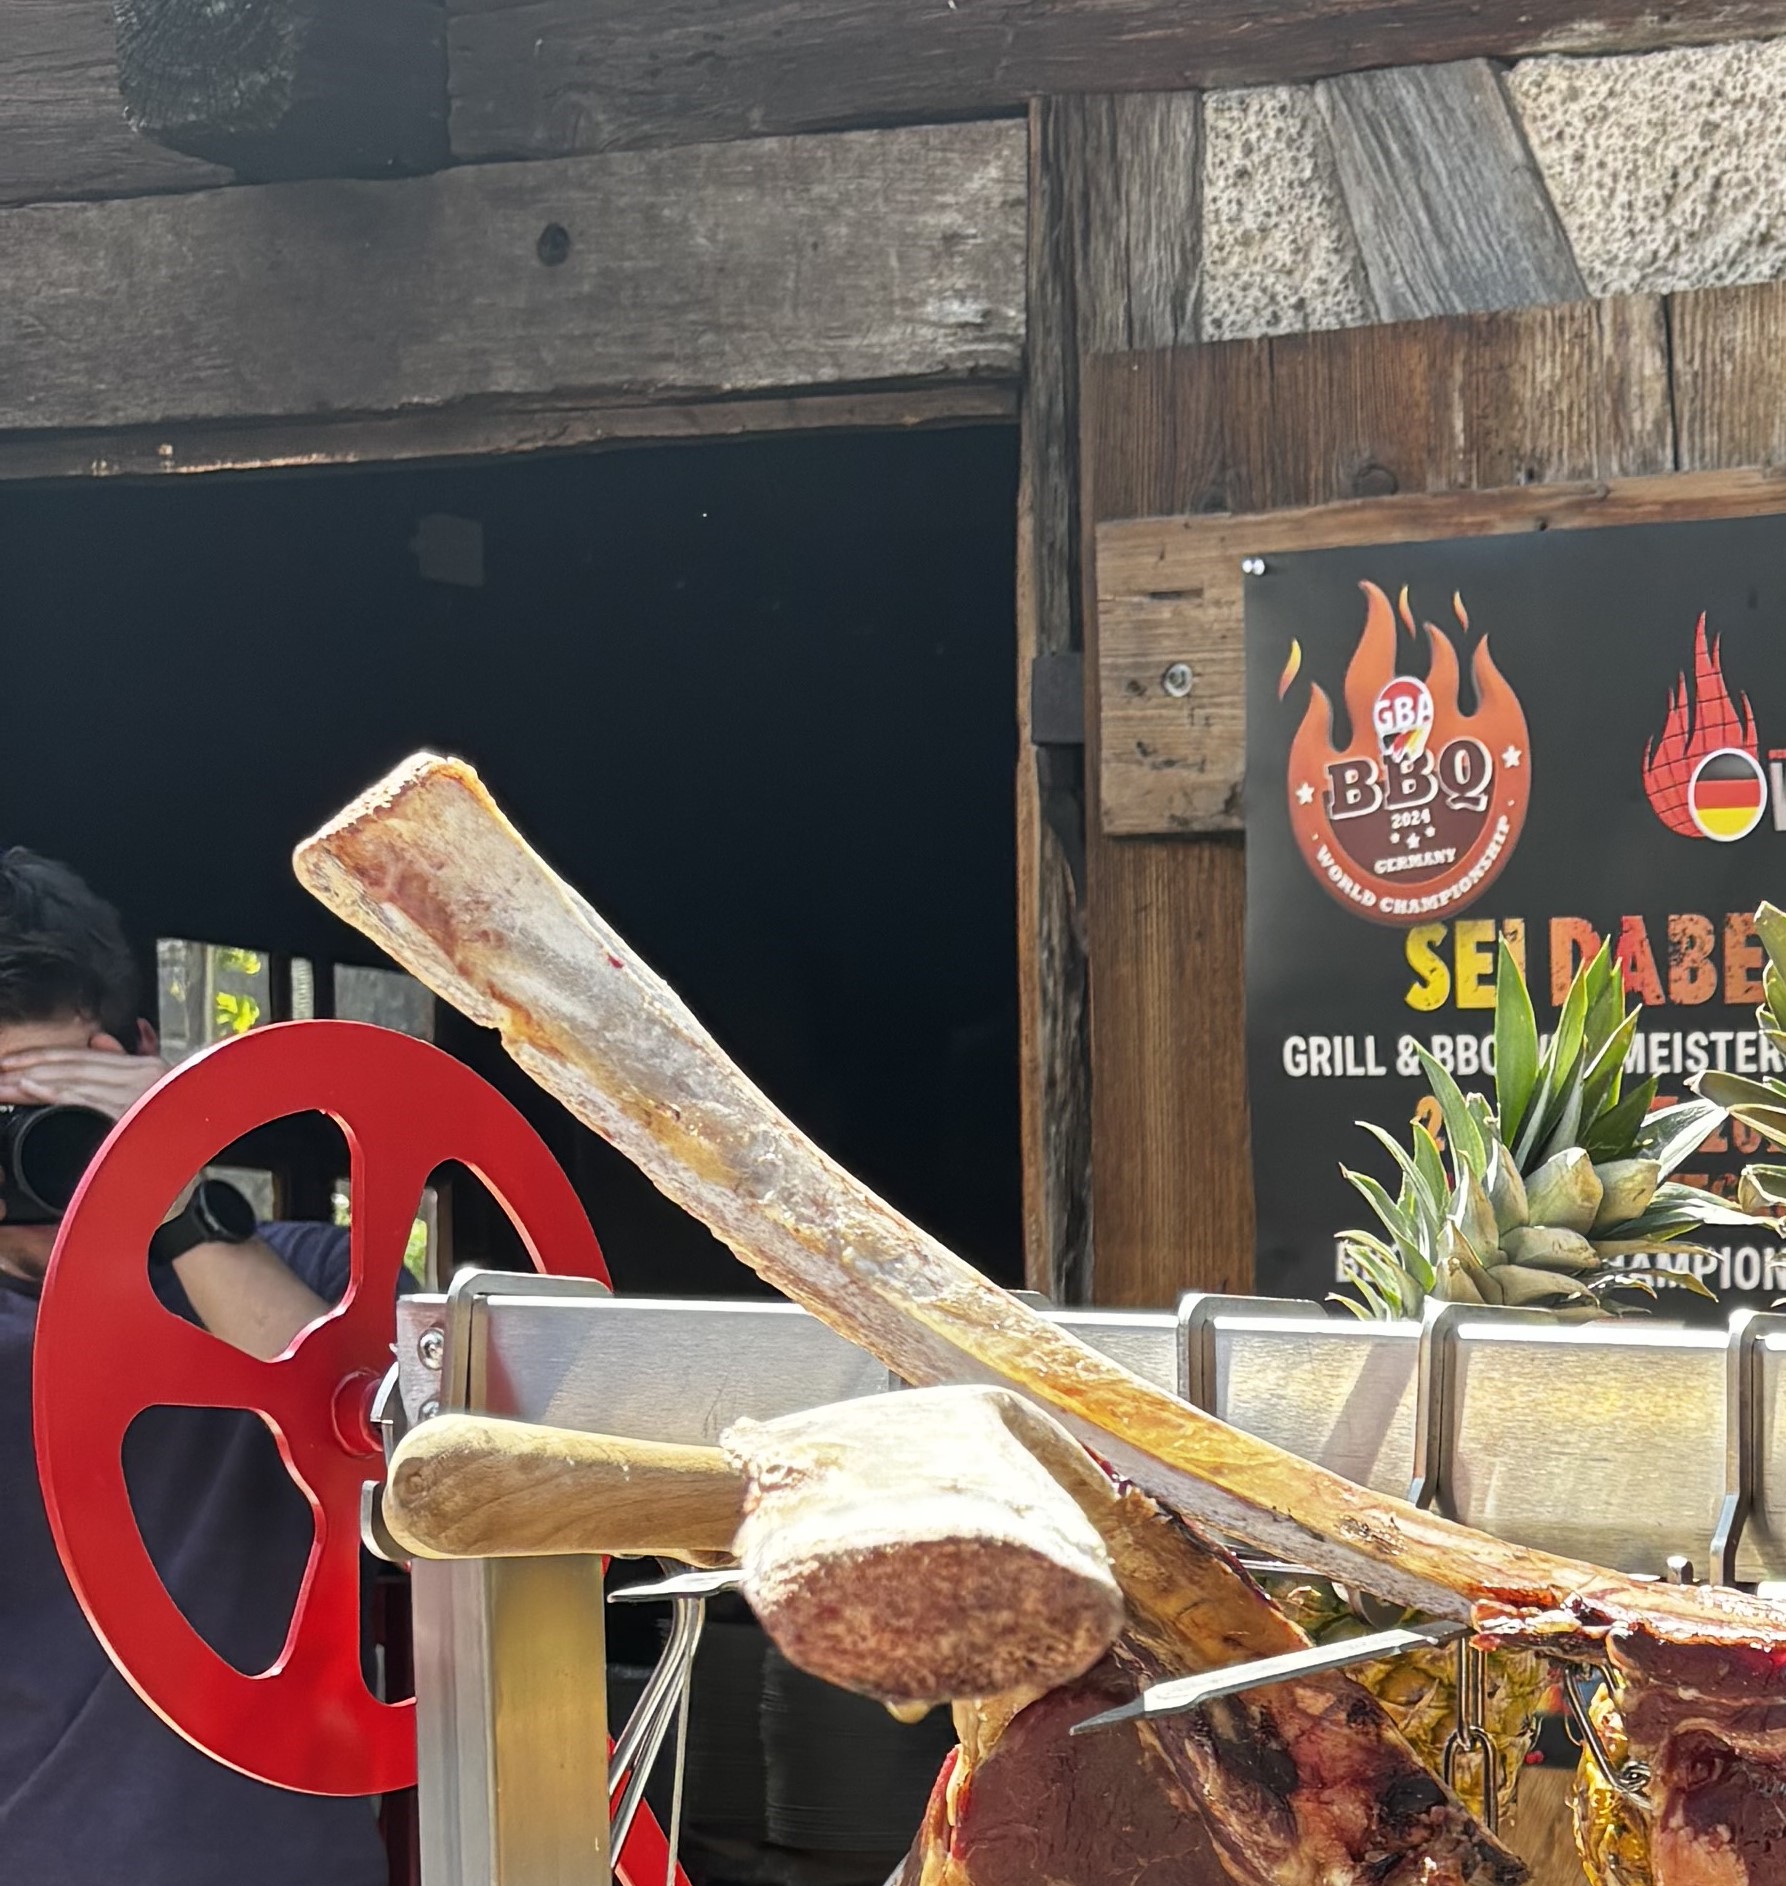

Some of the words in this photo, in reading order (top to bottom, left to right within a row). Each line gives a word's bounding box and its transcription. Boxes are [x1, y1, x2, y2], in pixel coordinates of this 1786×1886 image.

[1374, 693, 1432, 728] GBA
[1325, 737, 1492, 820] BBQ
[1391, 808, 1431, 829] 2024
[1316, 844, 1376, 907] WORLD
[1379, 815, 1510, 915] CHAMPIONSHIP
[1374, 848, 1456, 875] GERMANY
[1283, 1034, 1387, 1077] GRILL
[1396, 1034, 1421, 1076] &
